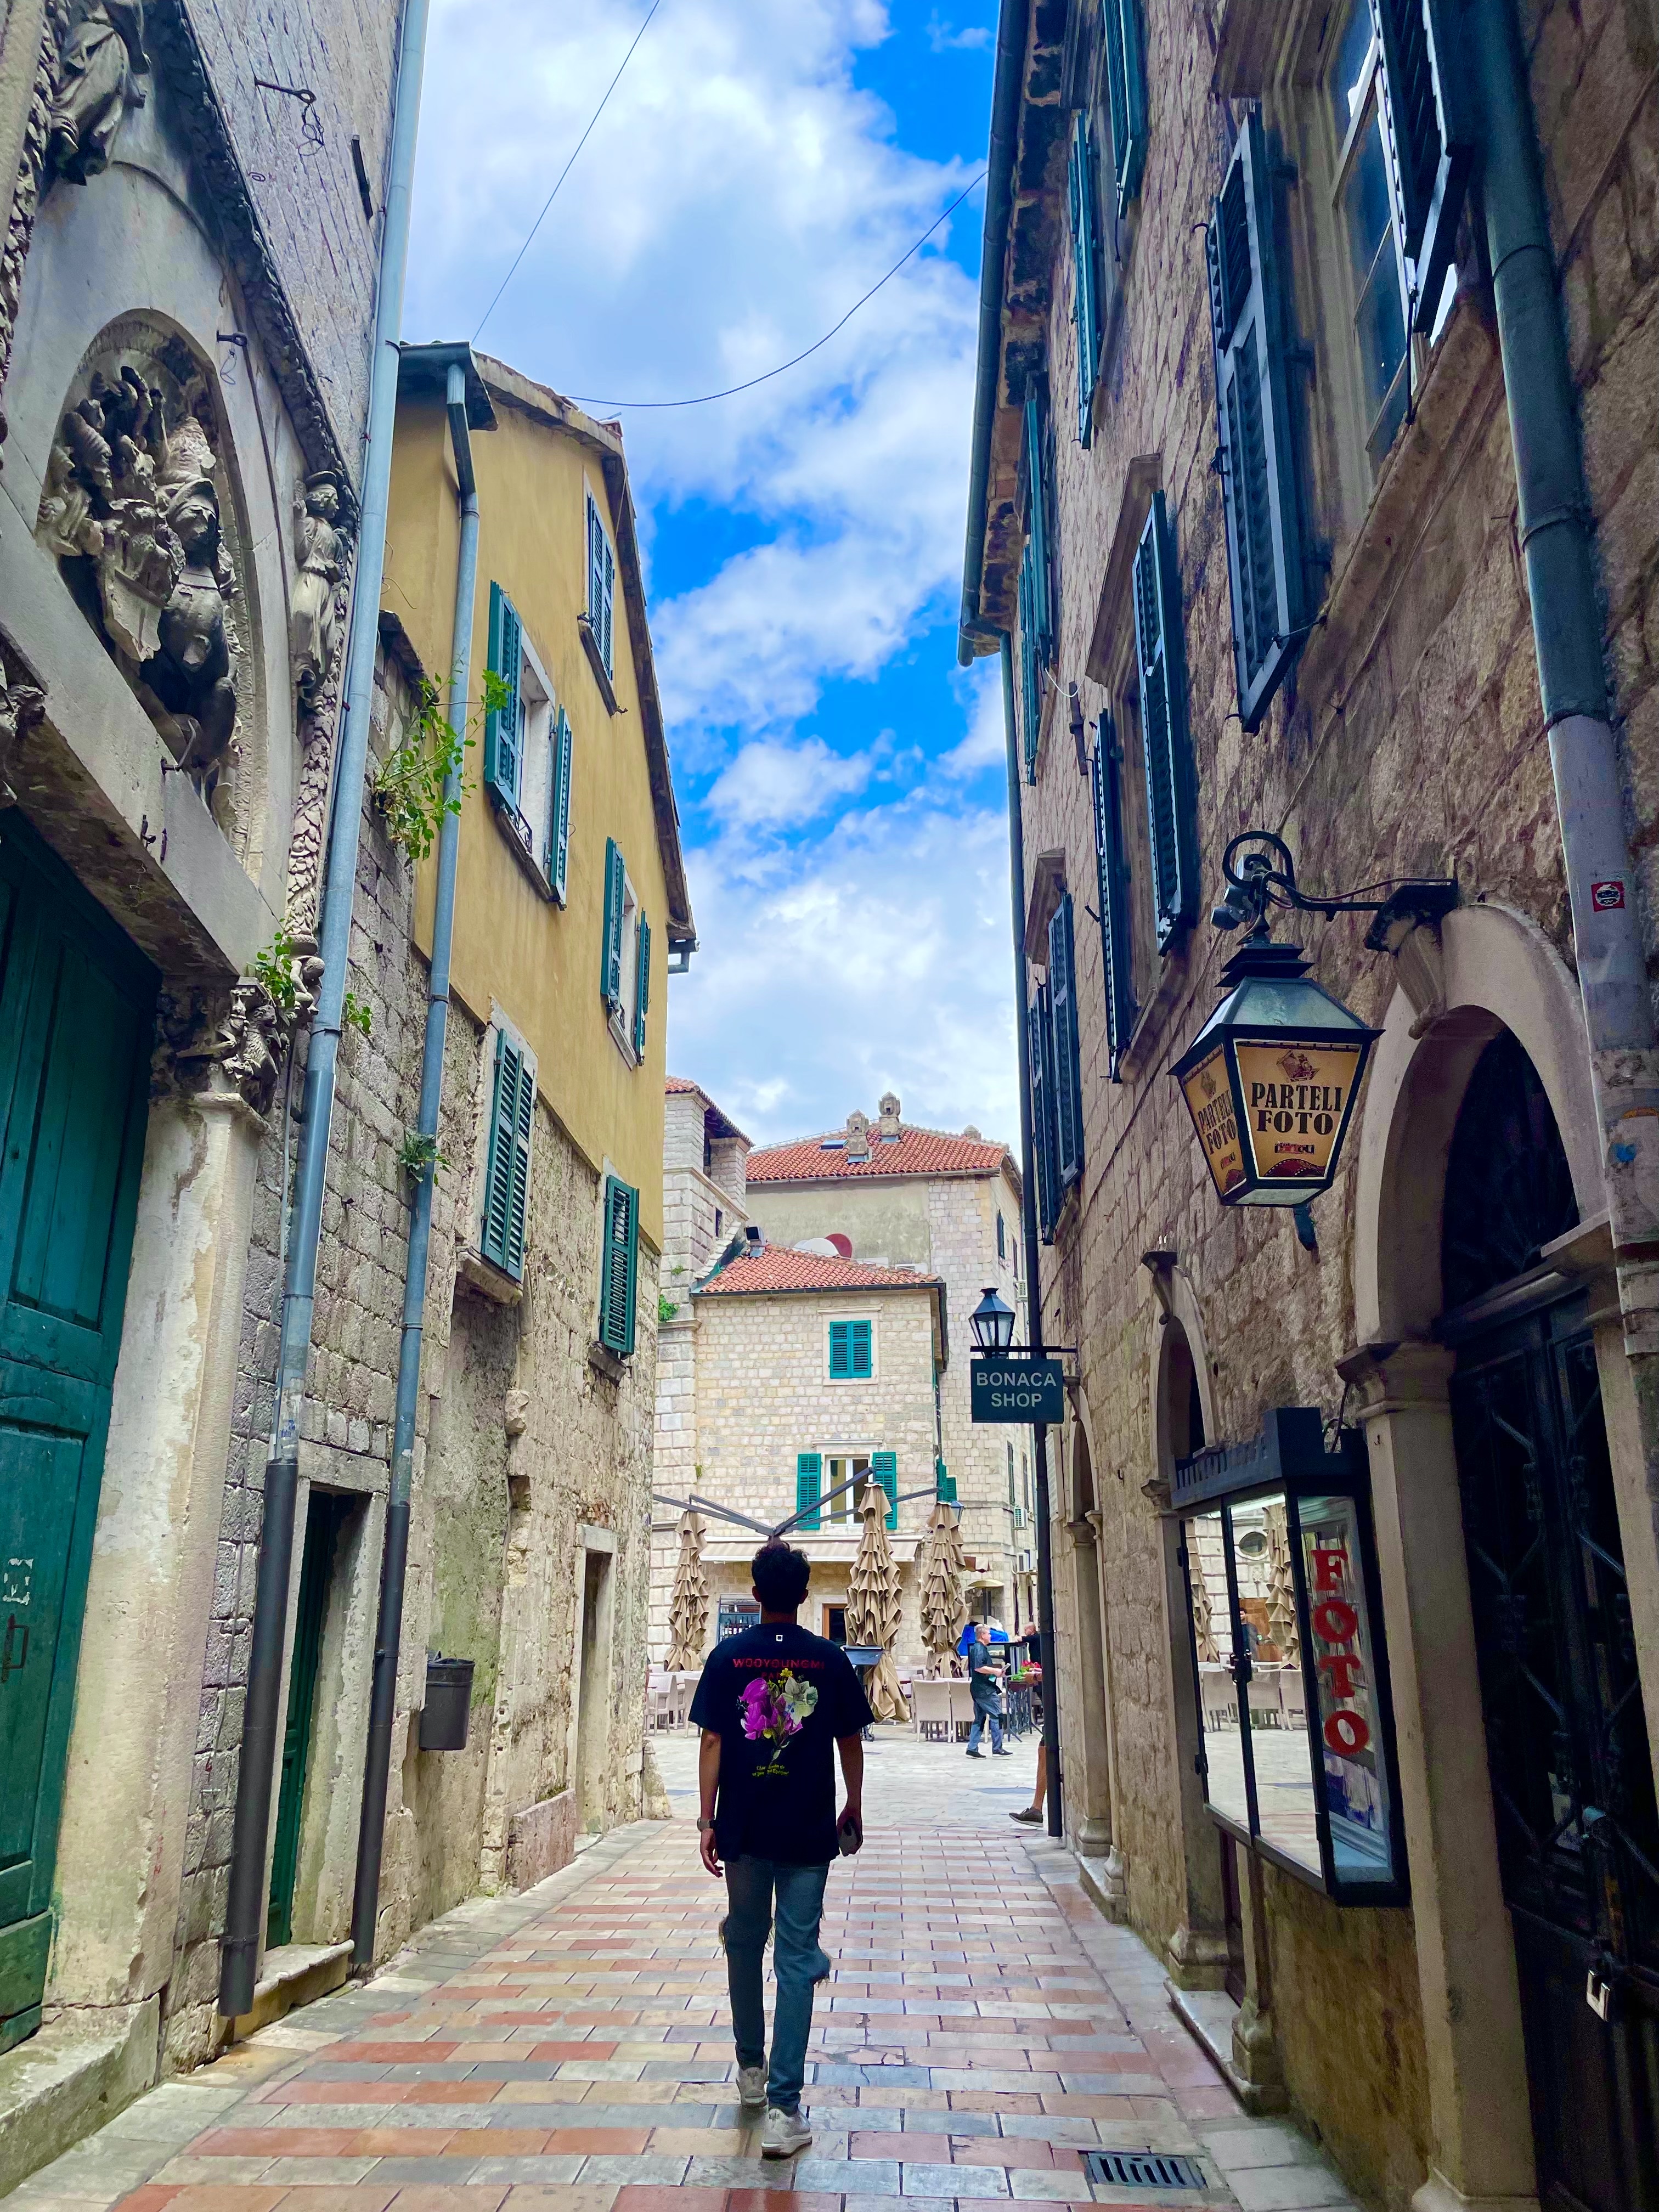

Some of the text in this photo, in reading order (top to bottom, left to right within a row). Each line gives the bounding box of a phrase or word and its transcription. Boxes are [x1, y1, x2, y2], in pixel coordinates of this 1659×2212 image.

[1251, 1082, 1342, 1111] PARTELI
[1198, 1089, 1233, 1135] PARTELI
[1256, 1110, 1333, 1135] FOTO
[1206, 1118, 1237, 1155] FOTO
[977, 1372, 1057, 1386] BONACA
[991, 1393, 1042, 1407] SHOP
[733, 1658, 825, 1669] WOOYOUNGMI
[1311, 1549, 1370, 1755] FOTO
